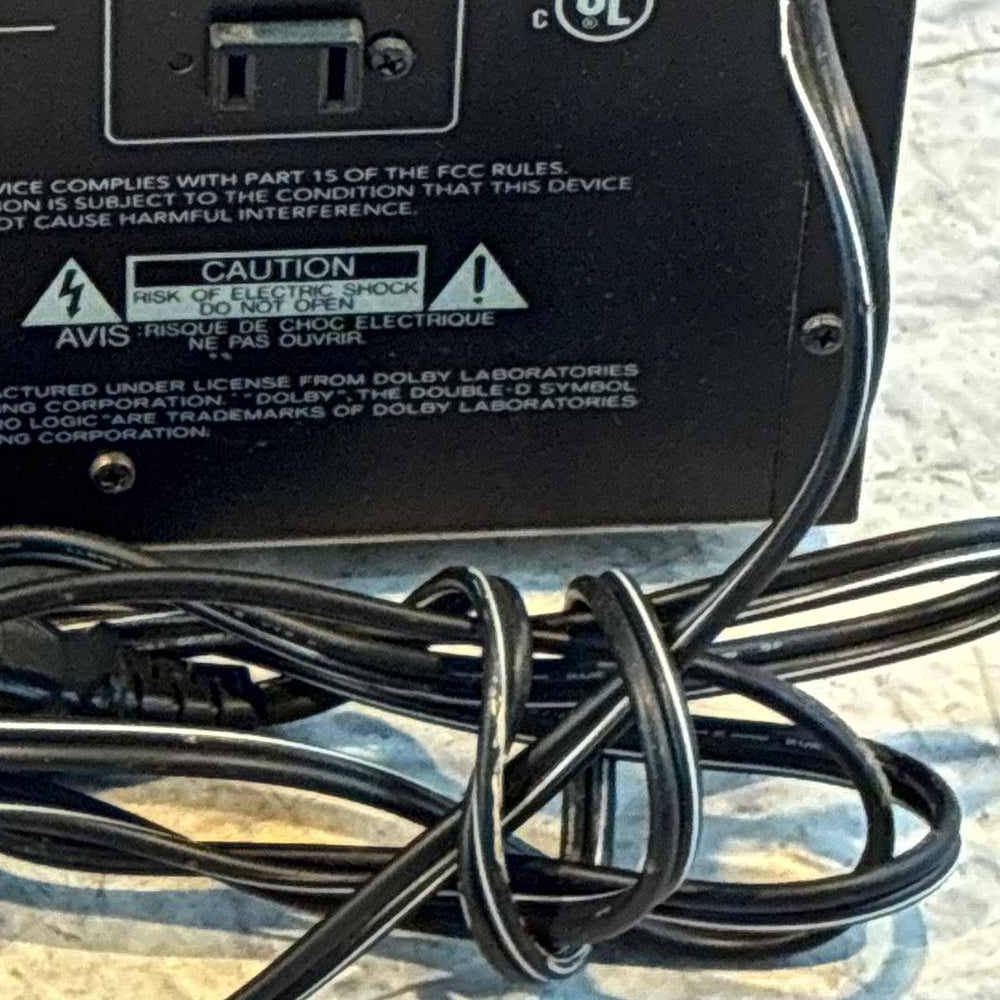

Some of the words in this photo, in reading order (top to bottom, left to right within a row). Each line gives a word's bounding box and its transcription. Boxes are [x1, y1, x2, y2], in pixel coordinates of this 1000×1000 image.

[50, 175, 169, 194] COMPLIES
[177, 172, 238, 188] WITH
[245, 170, 301, 186] PART
[313, 169, 337, 183] 15
[344, 167, 379, 182] OF
[385, 165, 430, 181] THE
[437, 163, 485, 179] FCC
[48, 198, 68, 212] IS
[74, 192, 176, 211] SUBJECT
[182, 190, 218, 206] TO
[224, 188, 268, 204] THE
[275, 183, 415, 202] CONDITION
[421, 181, 483, 197] THAT
[490, 180, 541, 195] THIS
[548, 176, 633, 193] DEVICE
[34, 212, 112, 230] CAUSE
[119, 207, 232, 226] HARMFUL
[202, 255, 355, 282] CAUTION
[133, 289, 181, 305] RISK
[190, 287, 221, 302] OF
[230, 283, 333, 301] ELECTRIC
[343, 280, 418, 297] SHOCK
[200, 301, 232, 316] DO
[240, 299, 282, 314] NOT
[293, 297, 354, 313] OPEN
[55, 324, 131, 350] AVIS
[239, 319, 268, 334] DE
[279, 316, 345, 333] CHOC
[354, 311, 495, 330] ELECTRIQUE
[188, 336, 218, 351] NE
[228, 334, 270, 349] PAS
[106, 379, 186, 395] UNDER
[193, 375, 291, 392] LICENSE
[300, 373, 365, 388] FROM
[373, 370, 451, 386] DOLBY
[459, 363, 640, 382] LABORATORIES
[358, 387, 401, 401] THE
[410, 382, 531, 399] DOUBLE-D
[539, 379, 637, 394] SYMBOL
[167, 405, 326, 423] TRADEMARKS
[332, 403, 363, 417] OF
[372, 401, 450, 417] DOLBY
[458, 395, 637, 413] LABORATORIES
